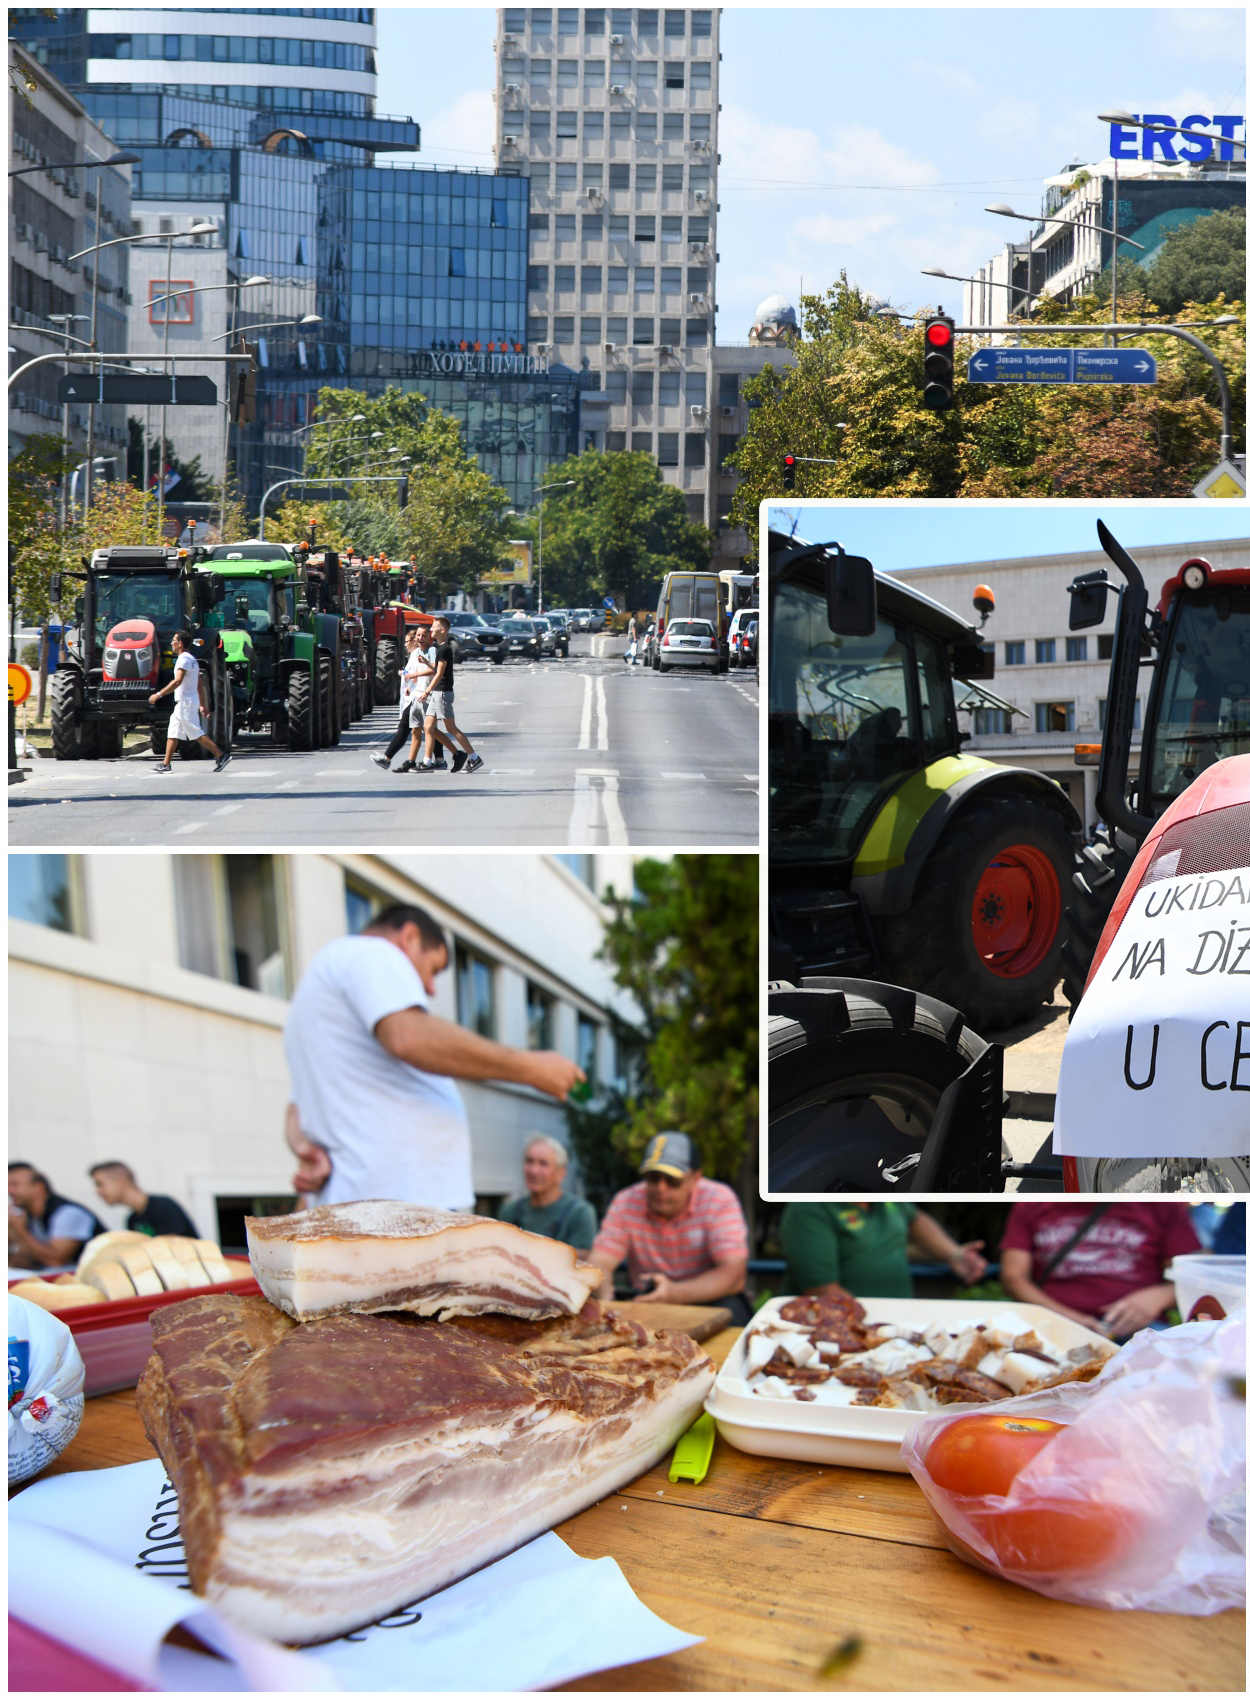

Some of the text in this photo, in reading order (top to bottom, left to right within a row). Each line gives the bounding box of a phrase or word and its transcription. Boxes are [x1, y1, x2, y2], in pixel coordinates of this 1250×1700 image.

[1110, 114, 1246, 162] ERST
[430, 353, 550, 374] ХОТЕЛ ПУПИН
[1111, 937, 1166, 982] NA
[1123, 1023, 1160, 1091] U
